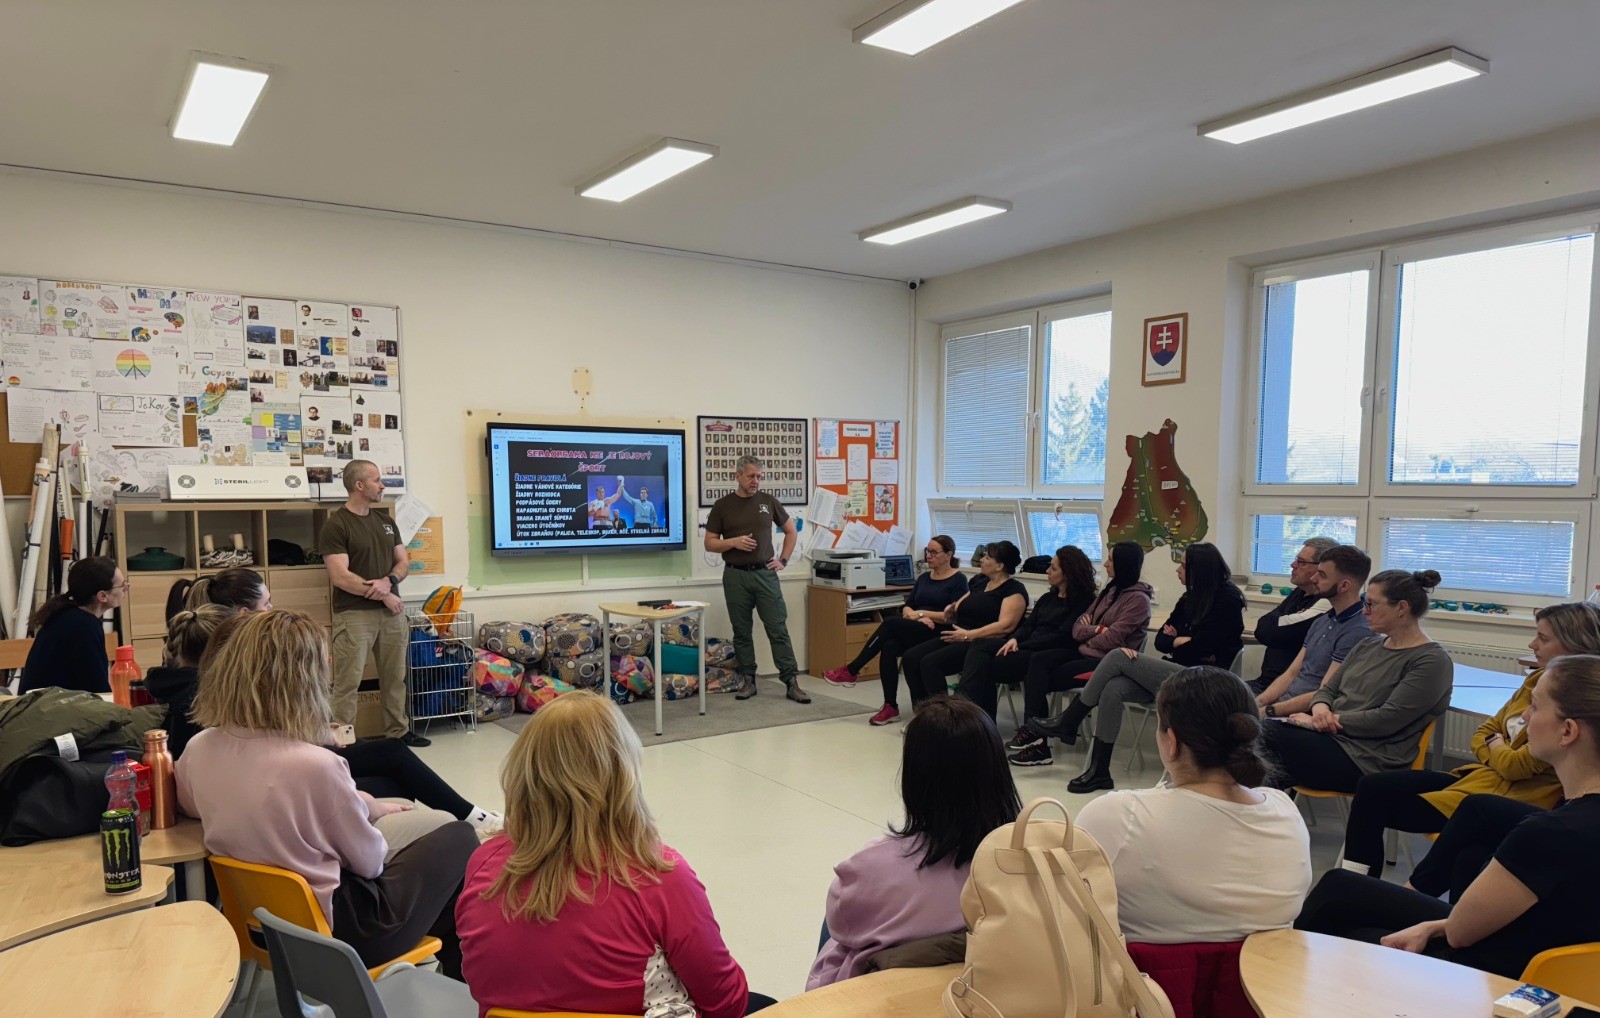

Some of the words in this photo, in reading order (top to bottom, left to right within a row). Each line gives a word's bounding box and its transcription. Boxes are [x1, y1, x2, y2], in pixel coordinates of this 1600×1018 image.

[189, 293, 211, 302] NEW
[179, 364, 196, 379] Fly
[201, 365, 236, 379] Geyser
[577, 461, 606, 472] ŠPORT
